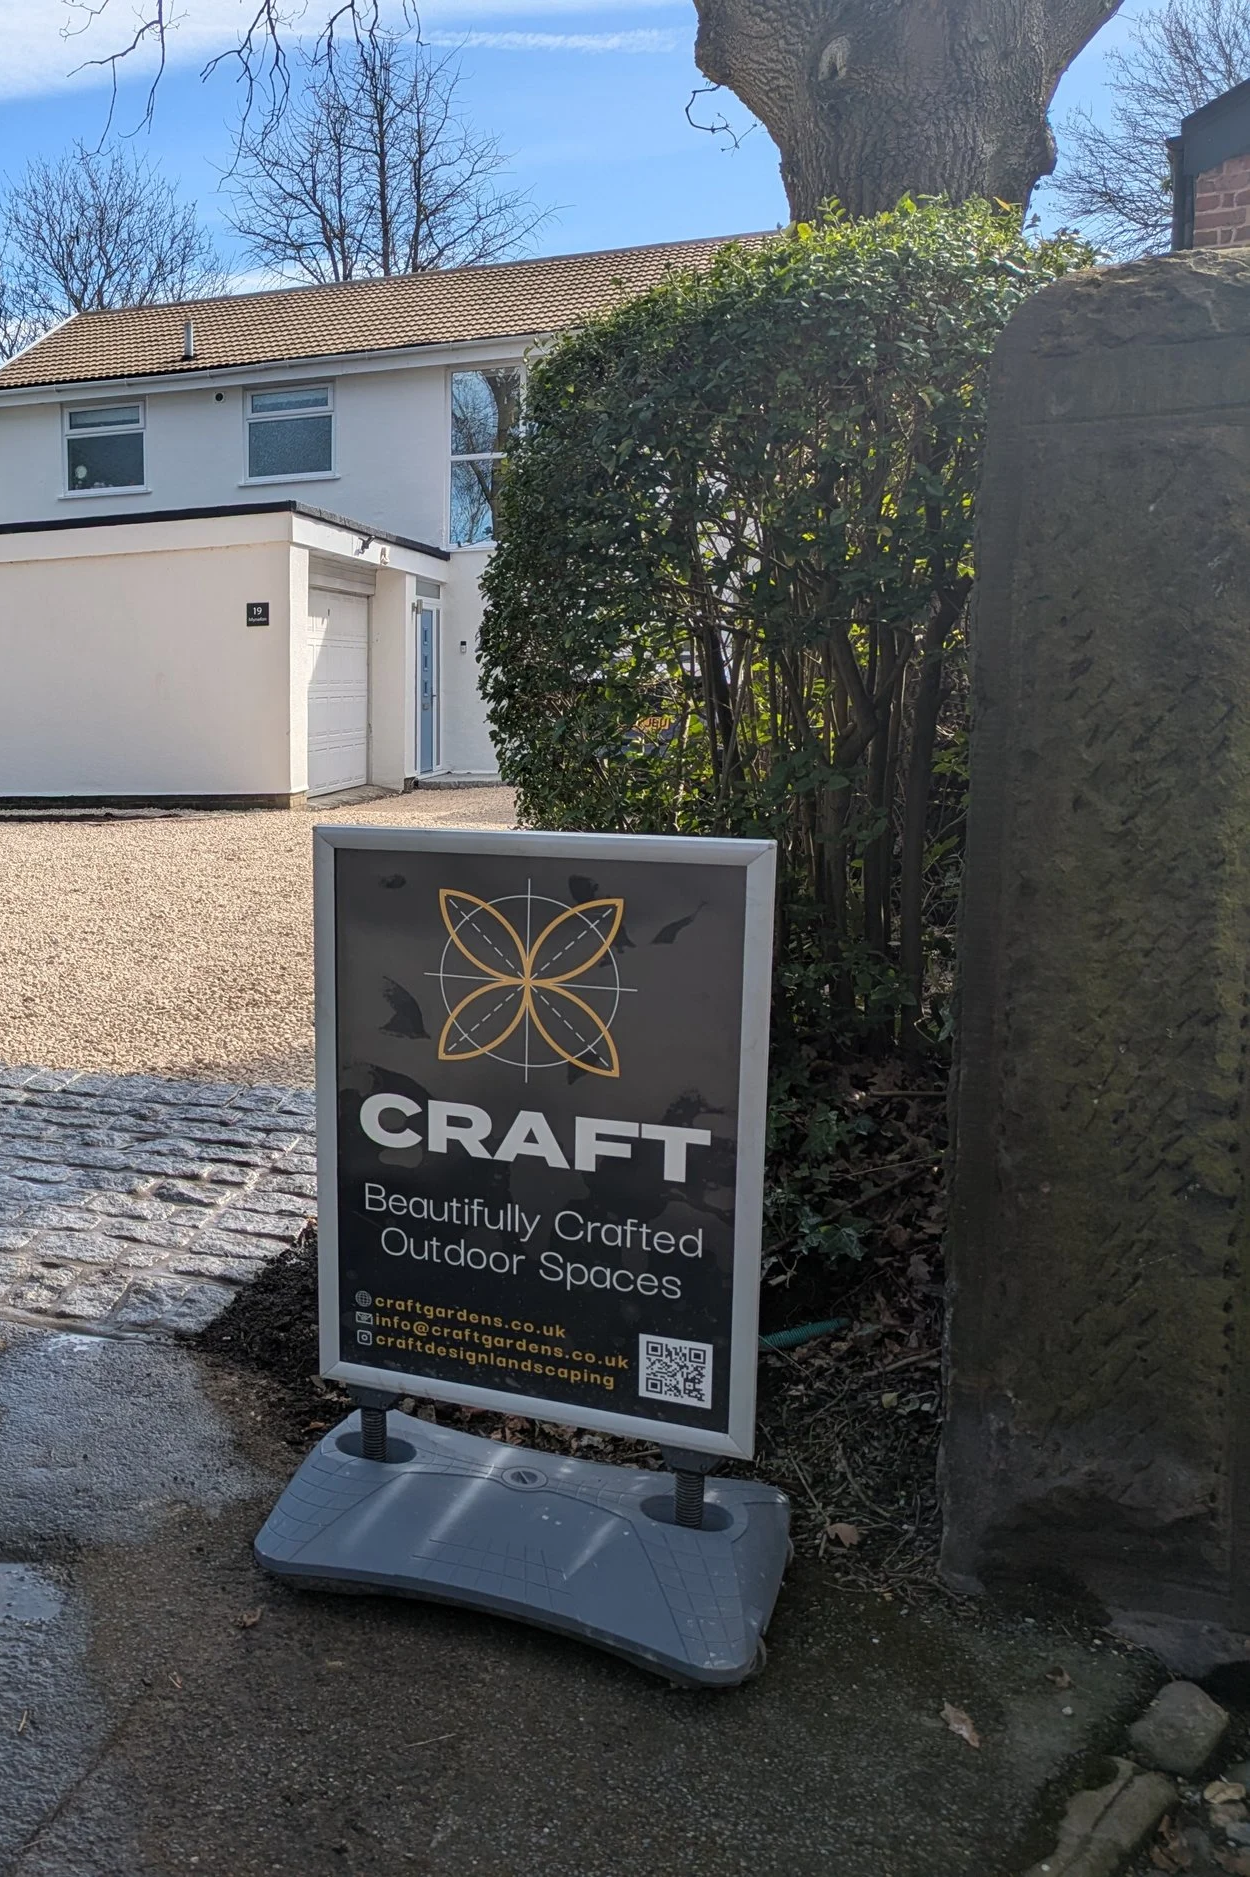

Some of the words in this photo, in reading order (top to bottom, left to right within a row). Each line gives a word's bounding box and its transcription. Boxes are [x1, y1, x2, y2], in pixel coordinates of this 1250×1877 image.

[253, 606, 263, 615] 19
[359, 1093, 711, 1183] CRAFT
[364, 1183, 541, 1242] Beautifully
[554, 1211, 703, 1258] Crafted
[380, 1227, 525, 1275] Outdoor
[539, 1251, 682, 1299] Spaces
[375, 1294, 566, 1338] craftgardens.co.uk
[375, 1313, 629, 1370] info@craftgardens.co.uk
[375, 1332, 615, 1390] craftdesignlandscaping
